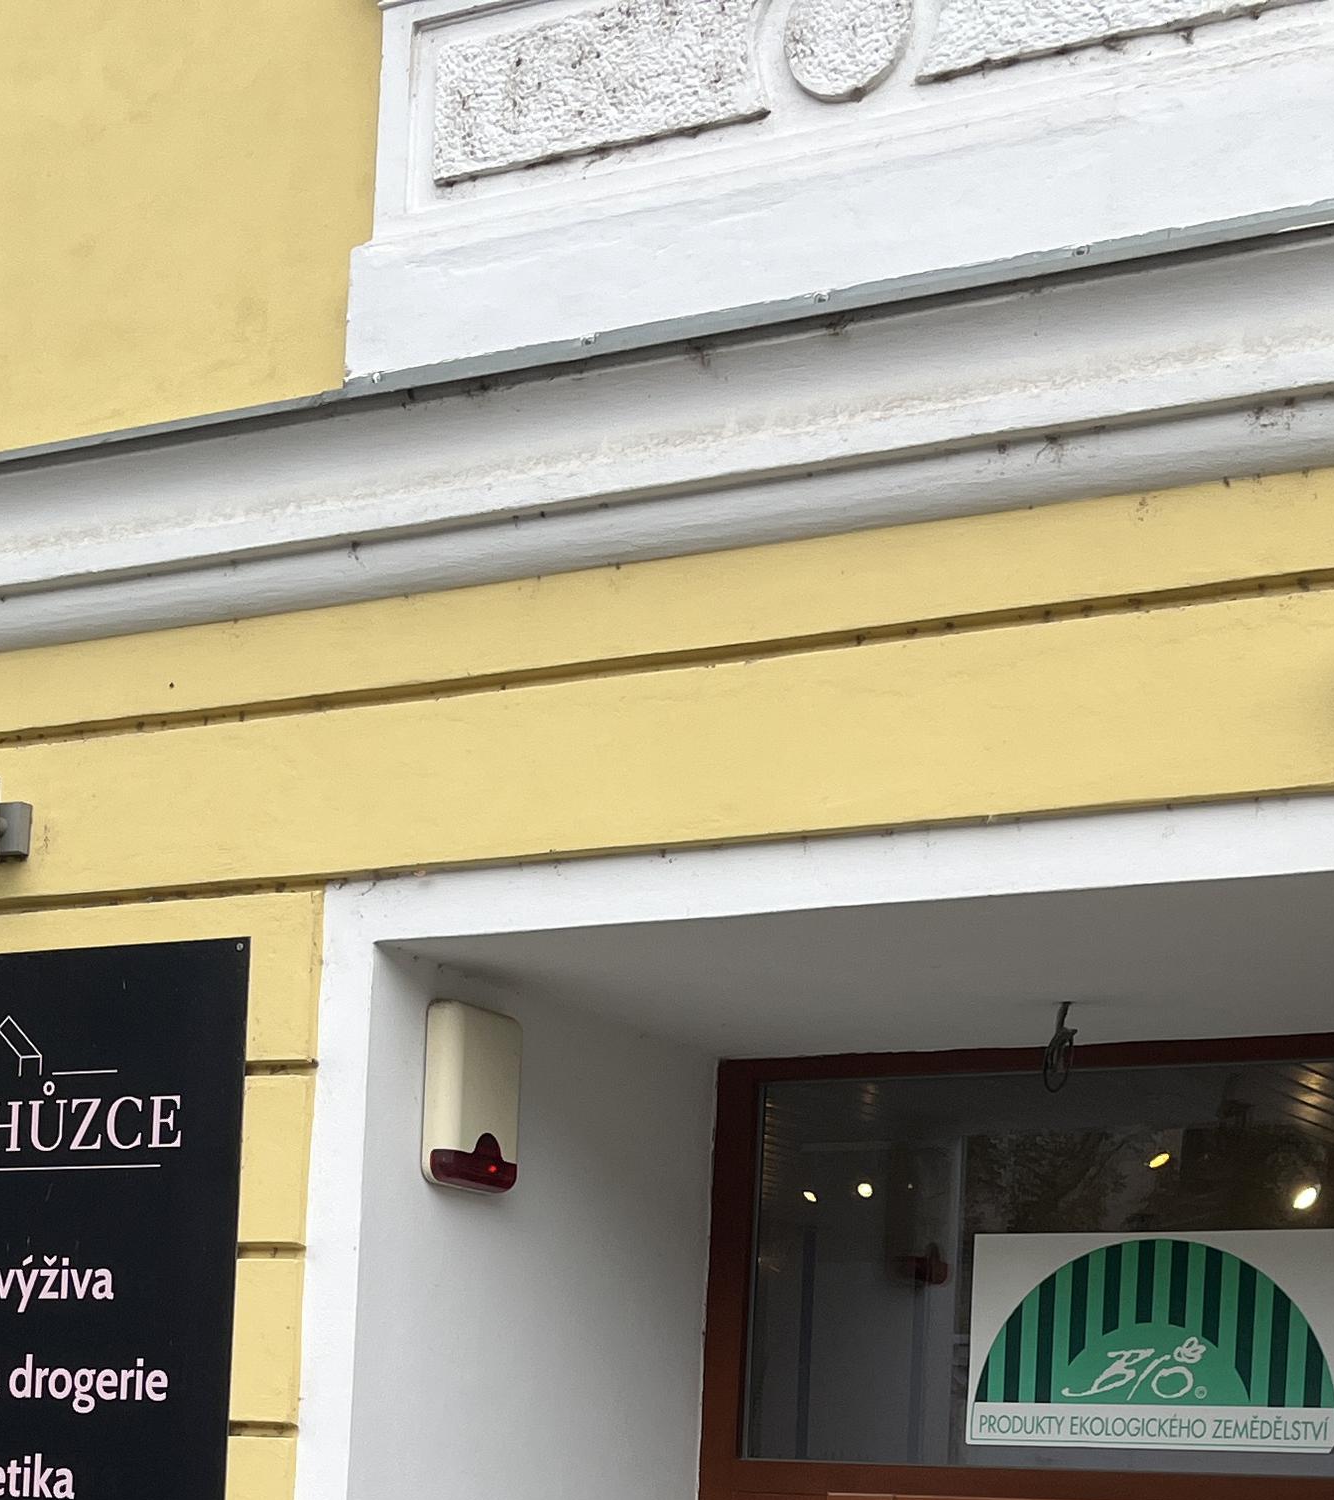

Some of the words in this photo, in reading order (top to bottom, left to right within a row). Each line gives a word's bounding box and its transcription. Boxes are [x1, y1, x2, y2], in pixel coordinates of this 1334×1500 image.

[8, 1354, 168, 1414] drogerie
[979, 1414, 1065, 1436] PRODUKTY
[1069, 1414, 1206, 1438] EKOLOGICKÉHO
[1212, 1415, 1329, 1441] ZEMĚDĚLSTVÍ
